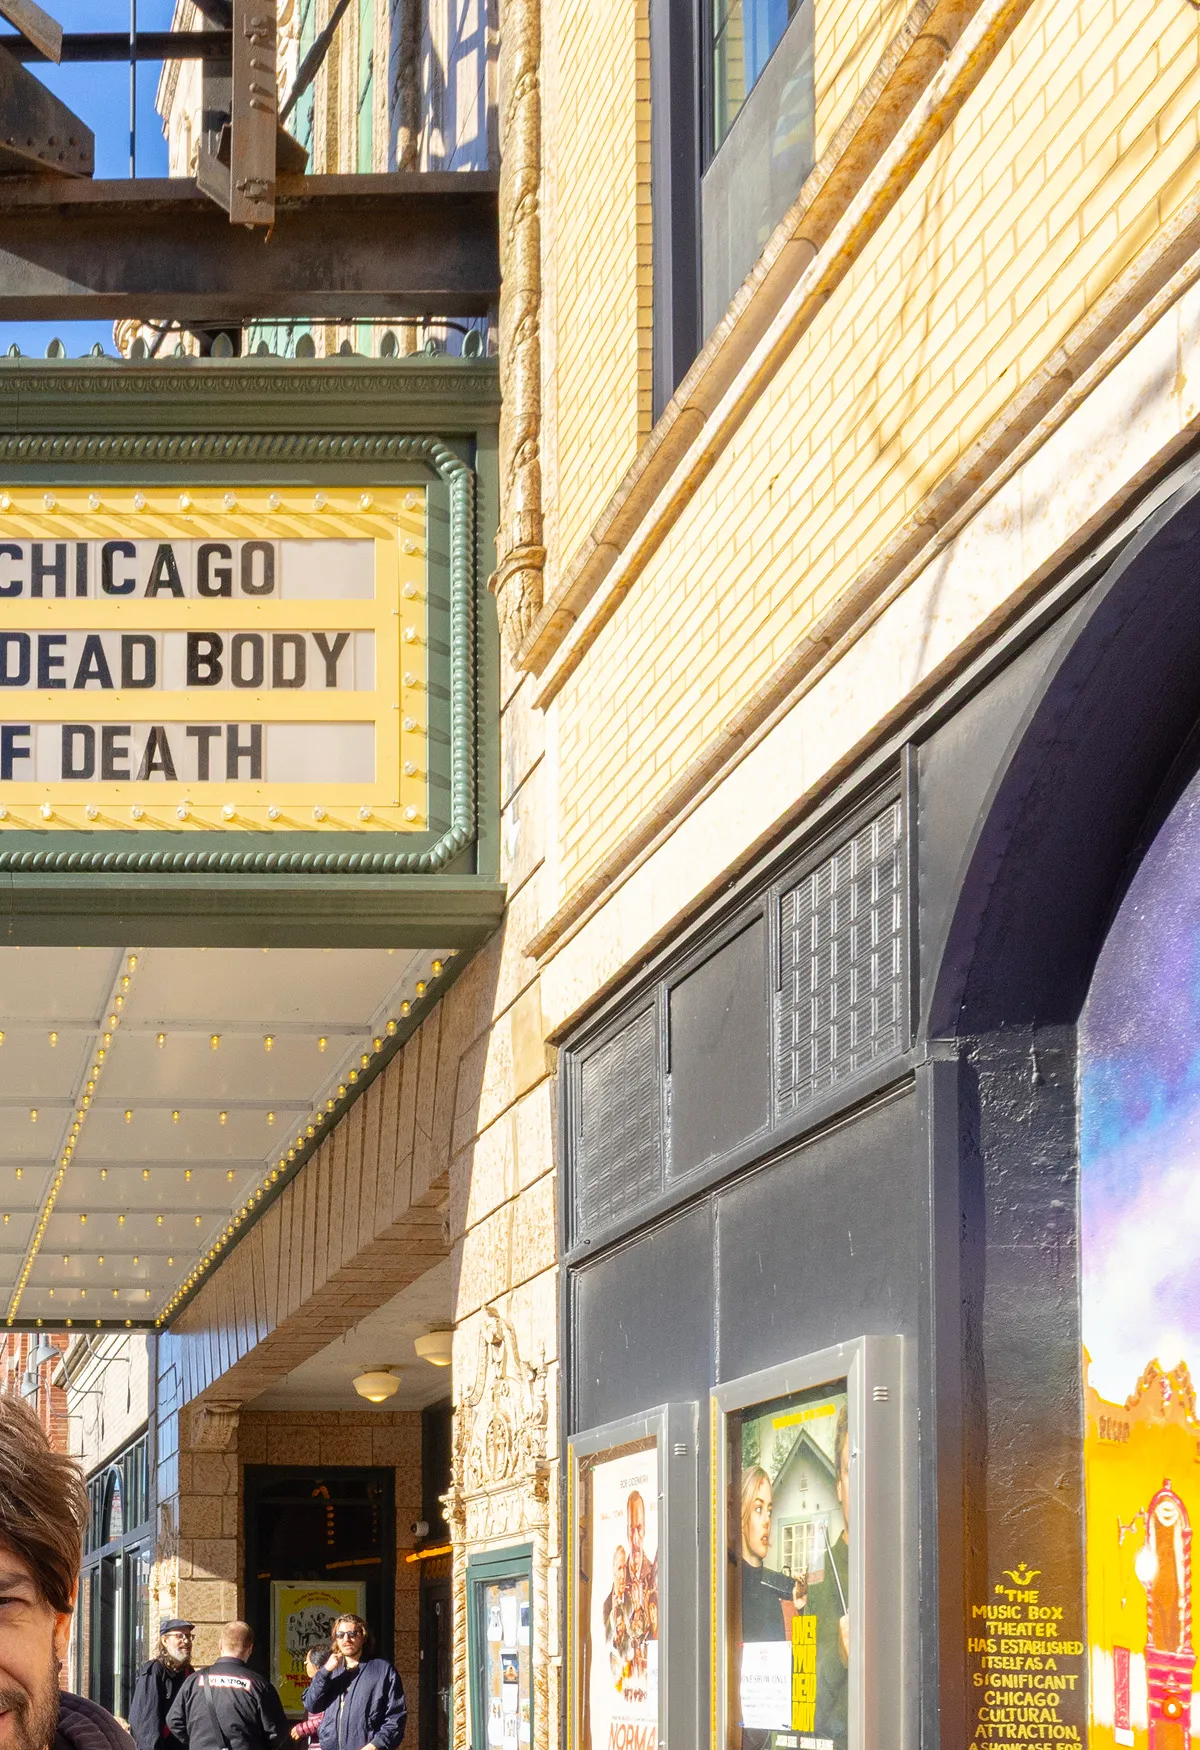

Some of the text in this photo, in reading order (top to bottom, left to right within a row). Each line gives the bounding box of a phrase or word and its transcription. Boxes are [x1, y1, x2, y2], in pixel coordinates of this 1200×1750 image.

[187, 631, 351, 689] BODY
[62, 724, 262, 781] DEATH
[972, 1605, 1064, 1620] MUSIC BOX
[986, 1621, 1058, 1637] THEATER
[968, 1638, 1084, 1655] HAS ESTABLISHED
[981, 1656, 1057, 1670] ITSELF AS A
[973, 1673, 1079, 1690] SIGNIFICANT
[984, 1691, 1060, 1706] CHICAGO
[978, 1707, 1063, 1722] CULTURAL
[975, 1724, 1081, 1741] ATTRACTION,
